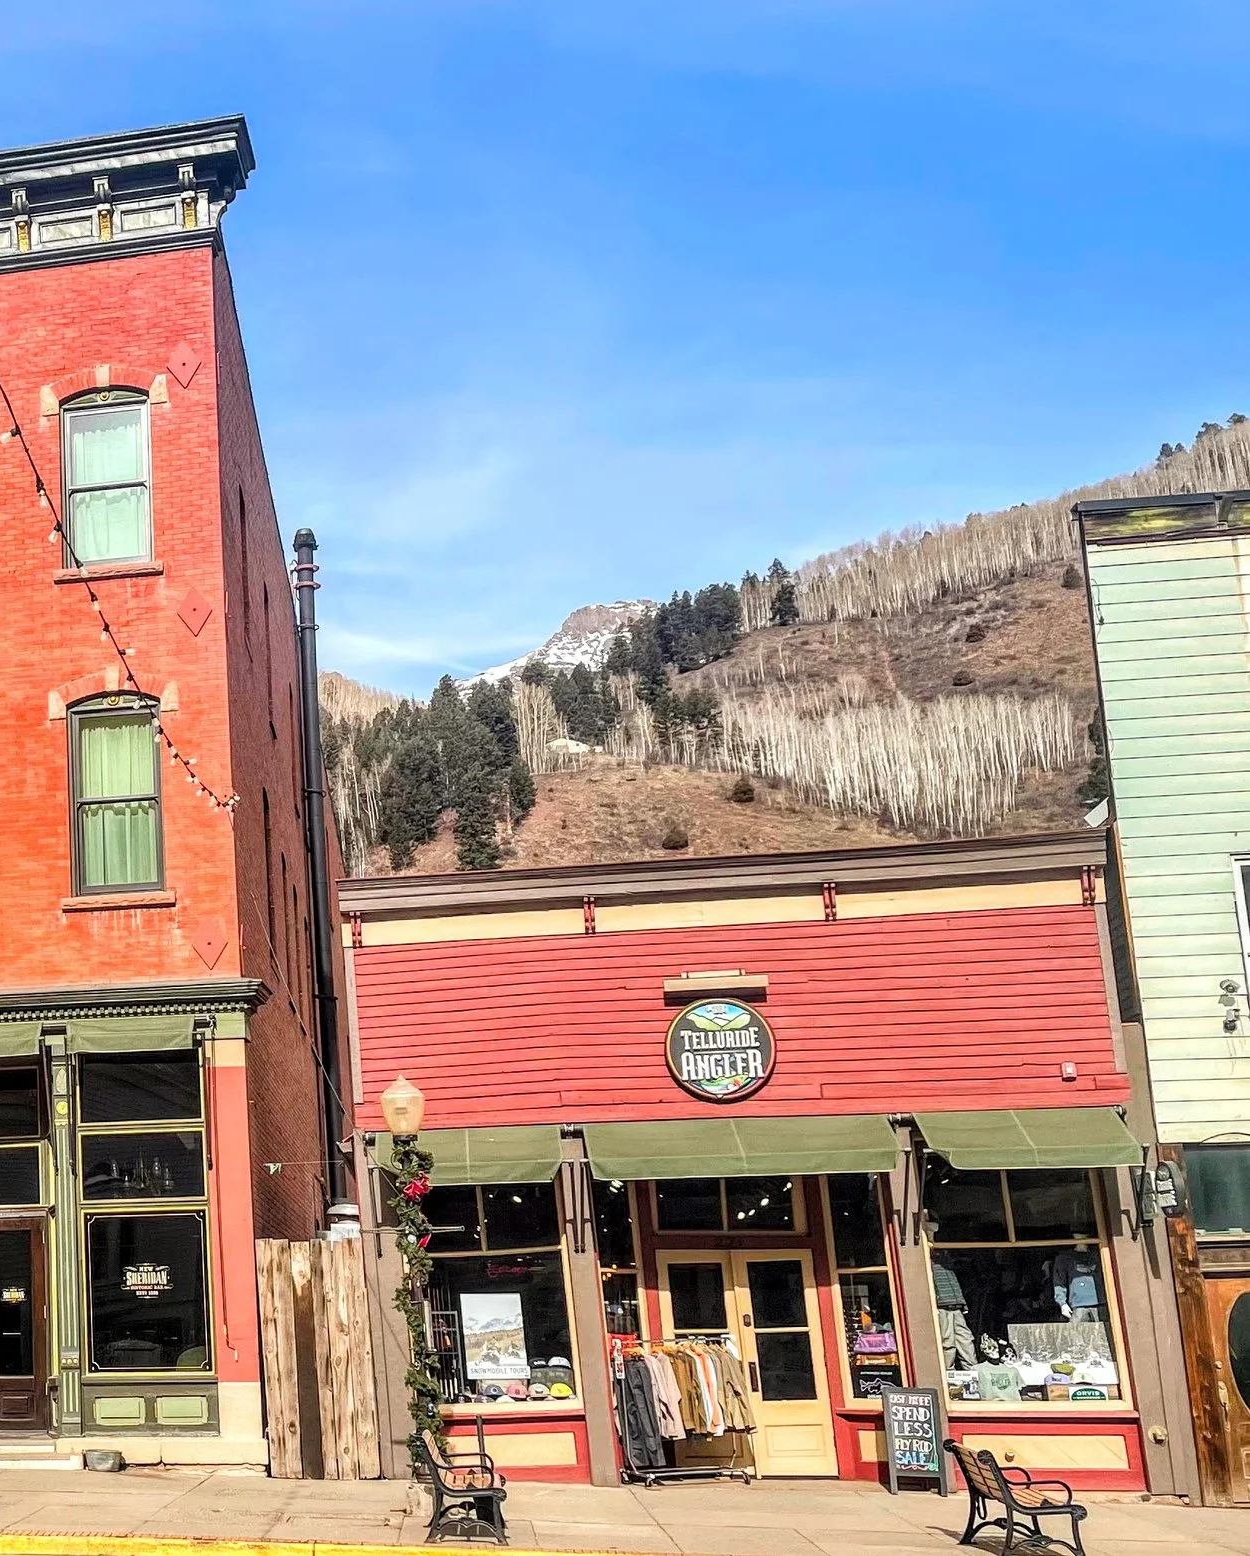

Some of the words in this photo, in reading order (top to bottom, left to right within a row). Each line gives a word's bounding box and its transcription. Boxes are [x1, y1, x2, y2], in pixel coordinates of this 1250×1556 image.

[680, 1026, 761, 1050] TELLURIDE
[680, 1048, 766, 1081] ANGLER
[126, 1270, 167, 1286] SHERIDAN
[470, 1367, 507, 1375] SNOWMOBILE
[509, 1366, 528, 1374] TOURS
[891, 1405, 930, 1421] SPEND
[893, 1421, 933, 1438] LESS
[895, 1438, 911, 1450] FLY
[912, 1438, 933, 1452] ROD
[895, 1450, 928, 1465] SALE
